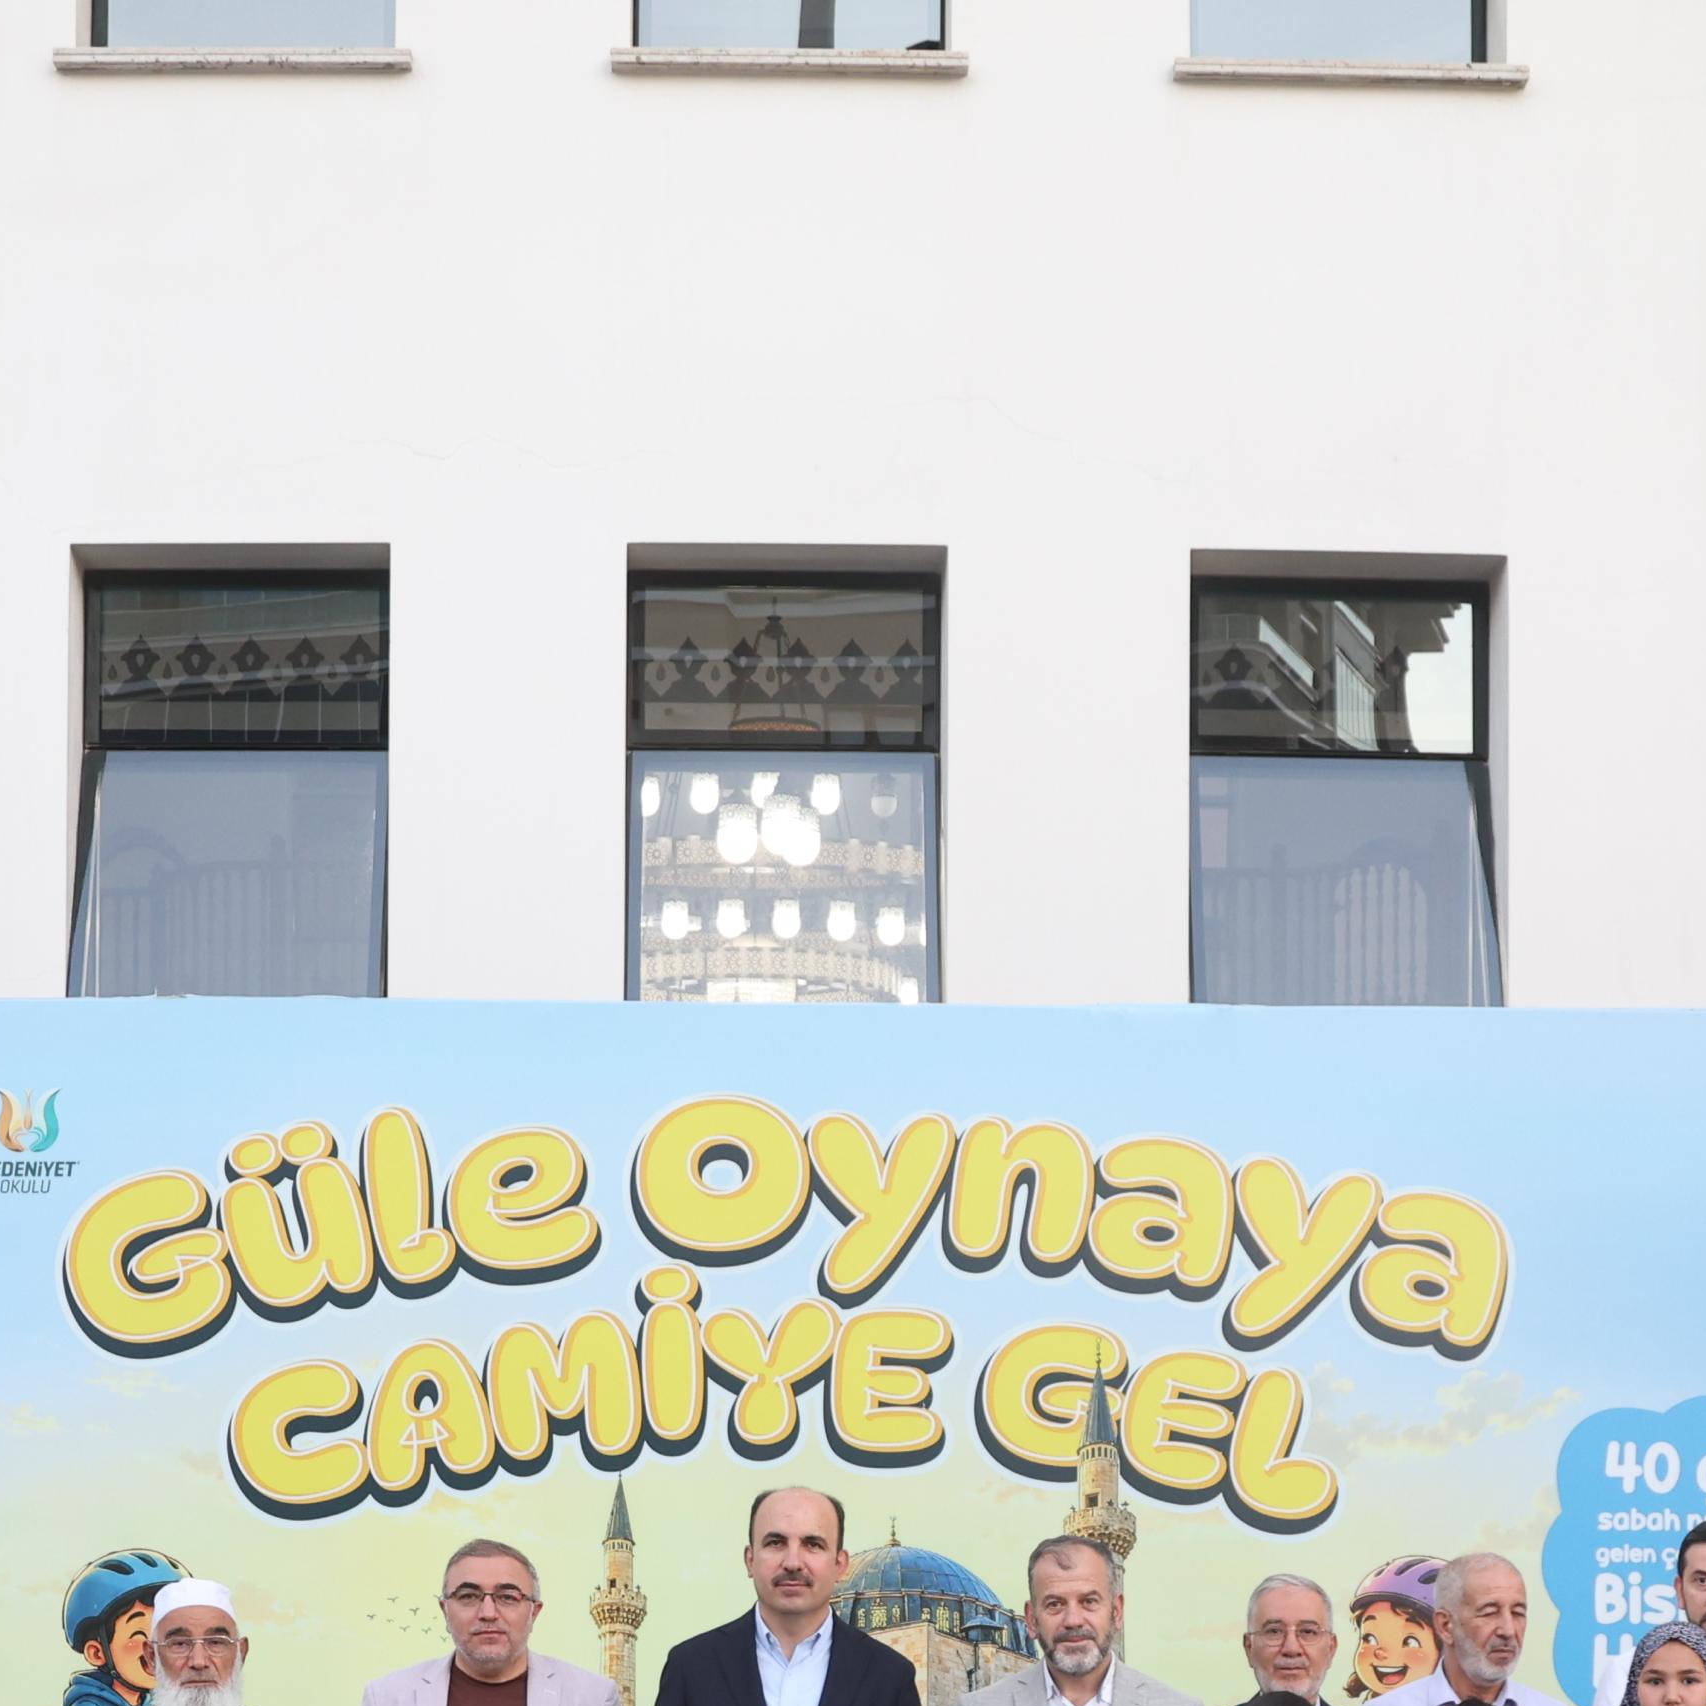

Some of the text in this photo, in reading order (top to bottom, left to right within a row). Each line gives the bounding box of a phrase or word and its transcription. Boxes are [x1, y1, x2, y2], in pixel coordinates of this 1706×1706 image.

[0, 1179, 51, 1194] OKULU
[66, 1095, 1508, 1360] Güle Oynaya
[977, 1322, 1339, 1524] GEL
[1605, 1440, 1681, 1493] 40
[1598, 1508, 1680, 1532] sabah
[1595, 1544, 1657, 1567] gelen
